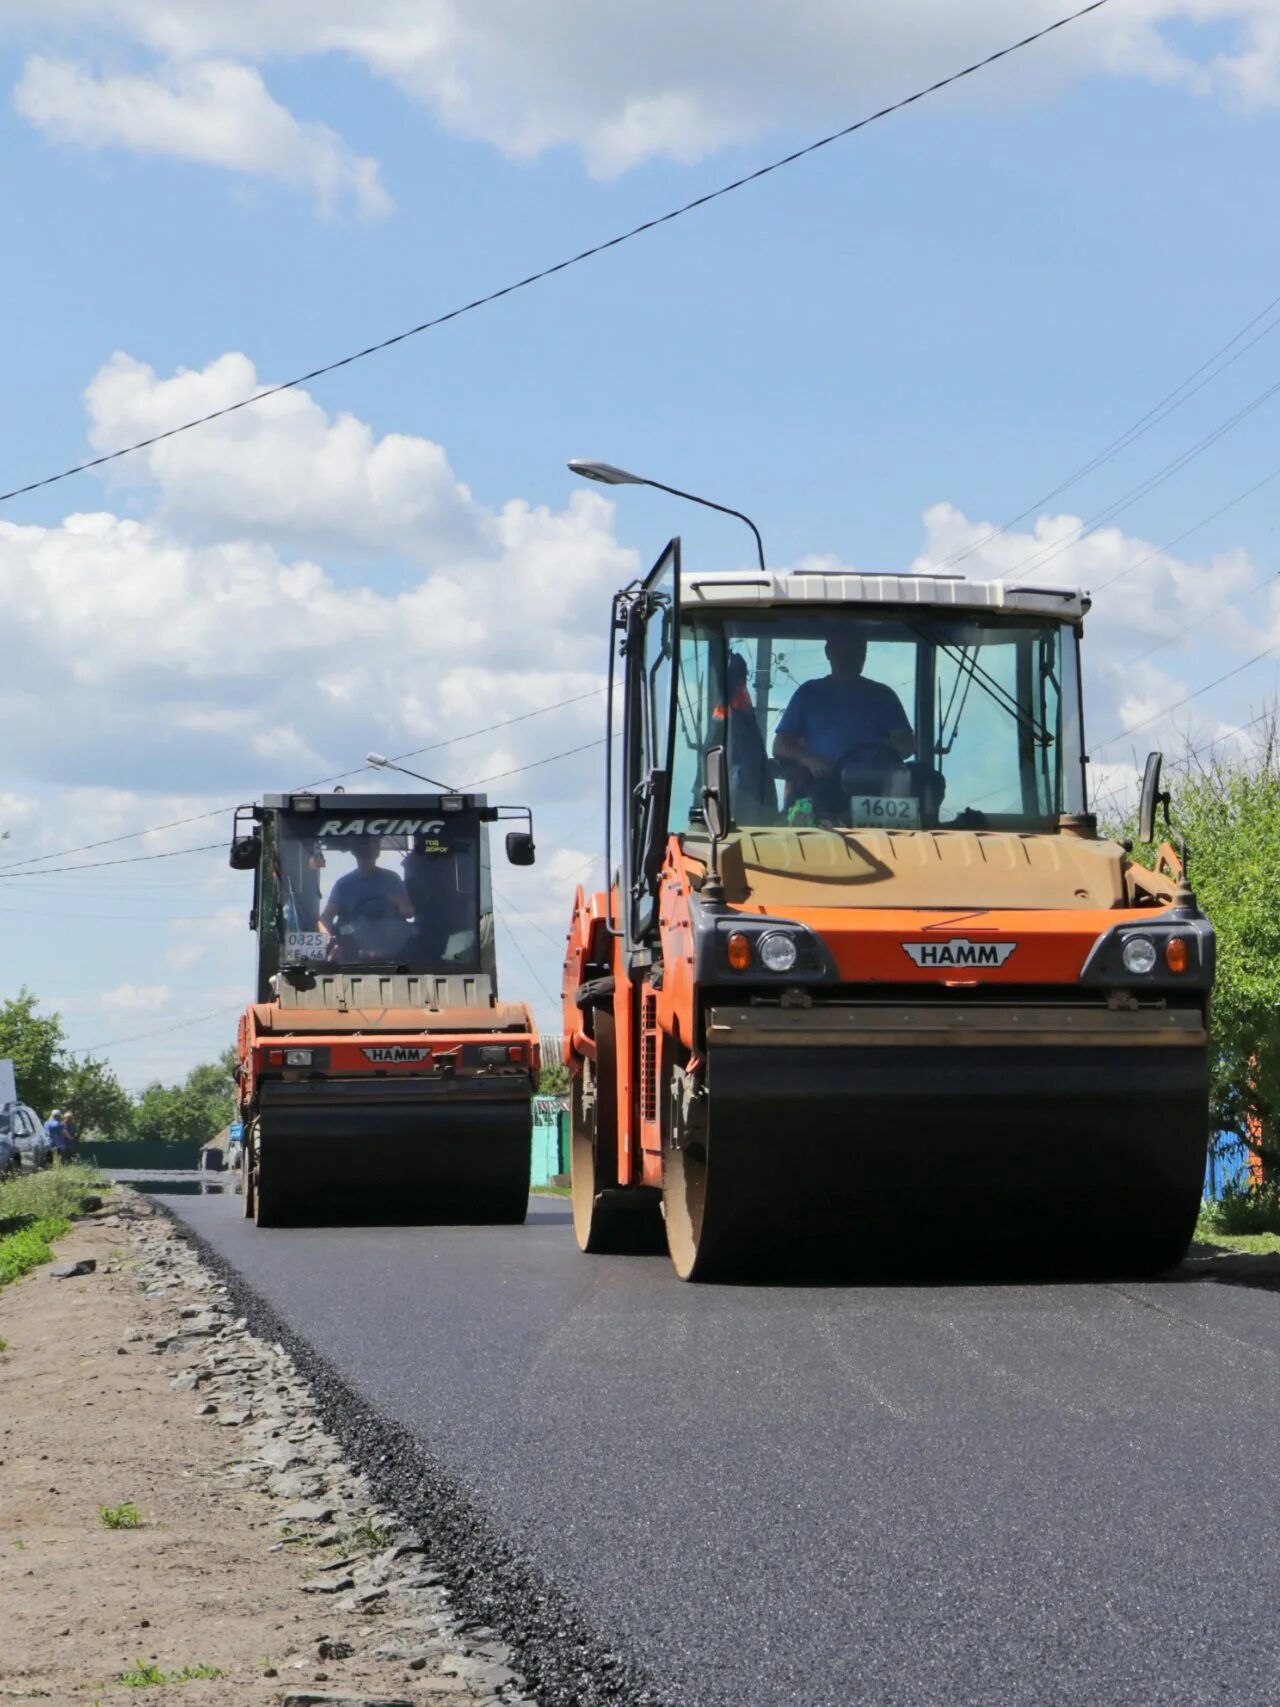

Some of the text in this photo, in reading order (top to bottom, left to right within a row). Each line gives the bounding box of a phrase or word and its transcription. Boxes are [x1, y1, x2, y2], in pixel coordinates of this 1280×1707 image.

[862, 799, 910, 818] 1602
[318, 819, 446, 836] RACING
[289, 934, 323, 946] 0825
[921, 946, 999, 964] HAMM
[372, 1049, 420, 1061] HAMM
